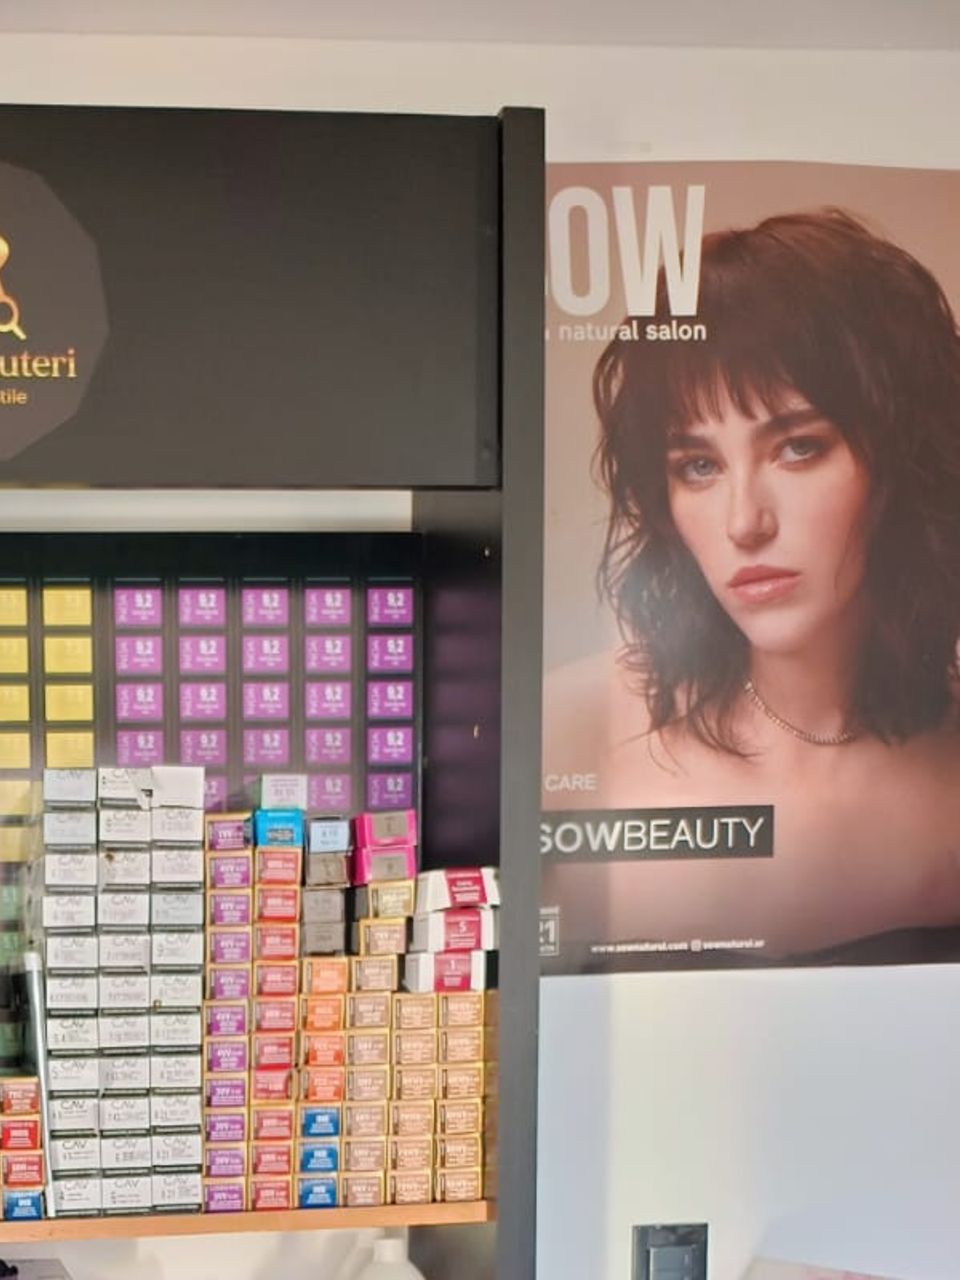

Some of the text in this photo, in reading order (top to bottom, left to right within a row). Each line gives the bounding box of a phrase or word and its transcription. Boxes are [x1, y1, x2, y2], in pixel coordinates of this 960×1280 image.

[545, 184, 705, 317] OW
[559, 321, 707, 342] natural salon
[545, 773, 597, 792] CARE
[540, 816, 765, 854] SOWBEAUTY
